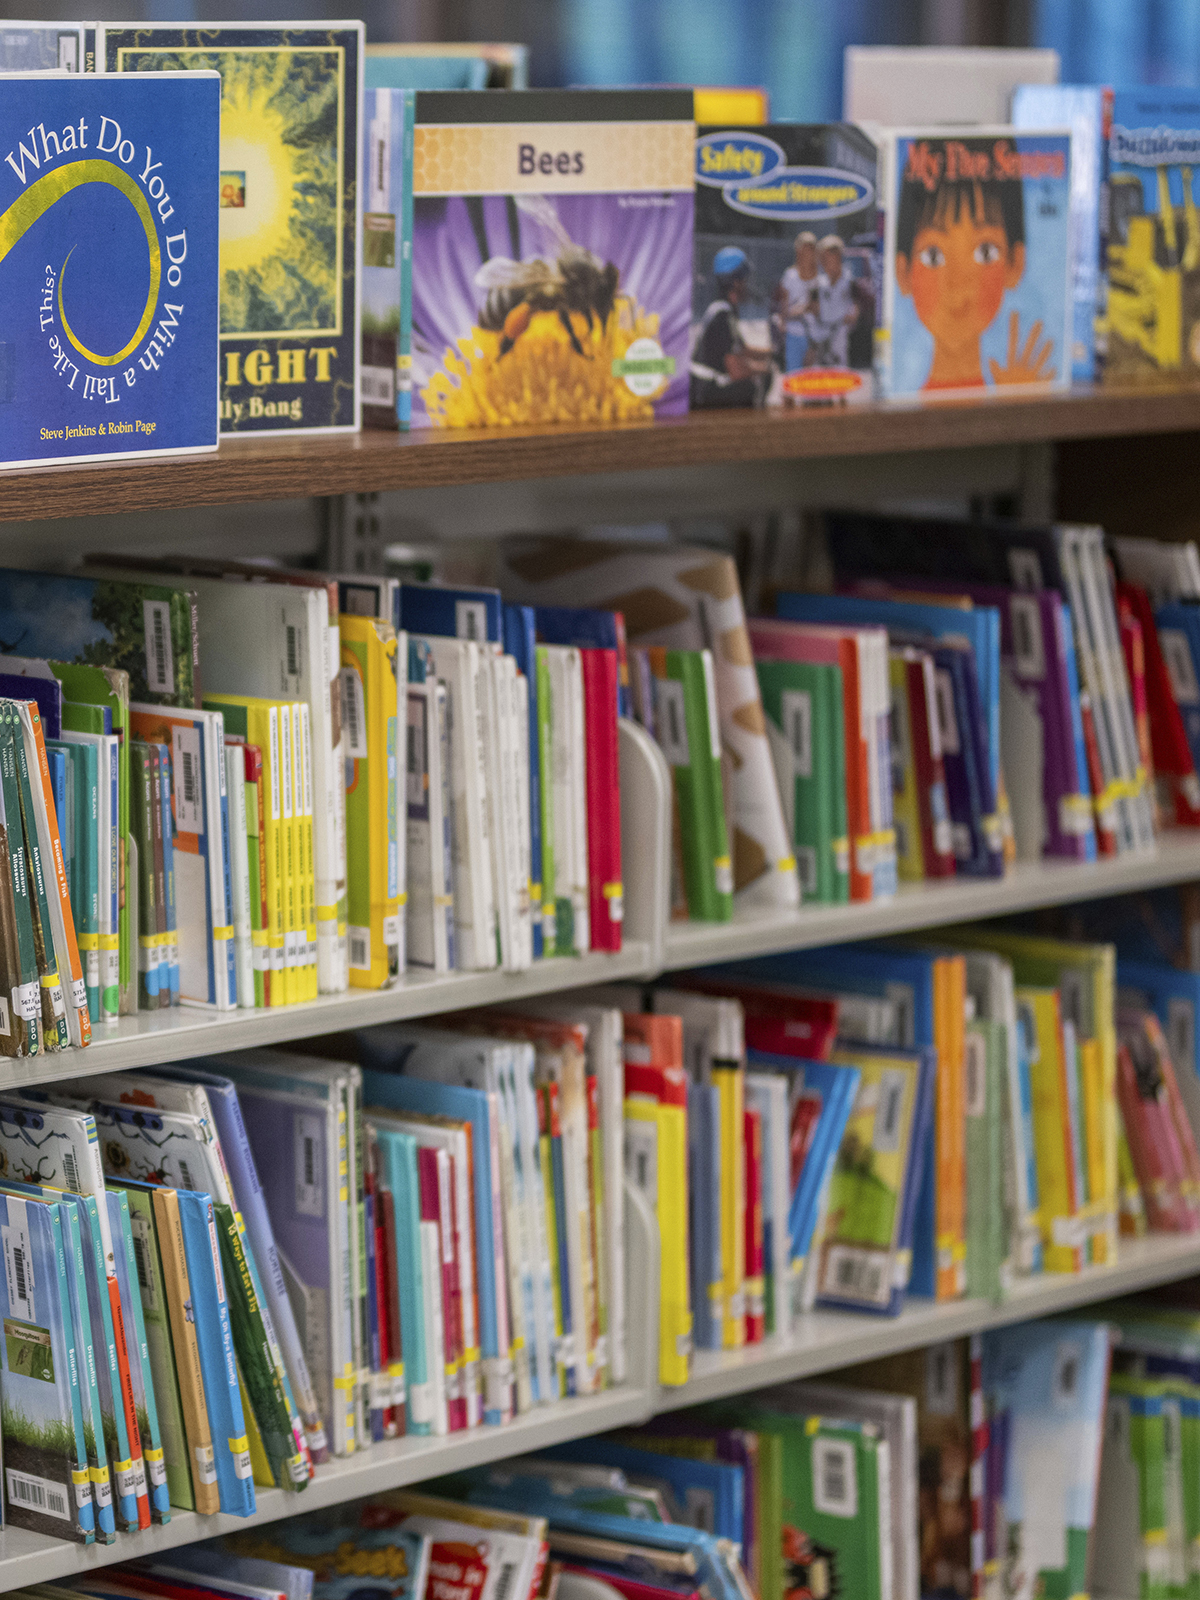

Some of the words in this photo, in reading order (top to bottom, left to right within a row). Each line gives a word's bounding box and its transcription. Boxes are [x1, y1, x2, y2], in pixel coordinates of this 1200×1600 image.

[4, 117, 89, 184] What
[96, 115, 135, 163] Do
[517, 144, 585, 175] Bees
[701, 144, 765, 177] Safety
[907, 141, 942, 193] My
[138, 146, 175, 224] You
[737, 182, 788, 205] around
[791, 181, 859, 208] Strangers
[166, 229, 187, 287] Do
[40, 264, 57, 332] This?
[138, 303, 184, 371] With
[49, 335, 80, 390] Like
[123, 367, 136, 387] a
[220, 347, 338, 386] IGHT
[83, 374, 120, 404] Tail
[249, 397, 303, 419] Bang
[40, 427, 64, 440] Steve
[65, 424, 97, 440] Jenkins
[98, 424, 107, 435] &
[108, 422, 133, 435] Robin
[135, 420, 157, 435] Page
[190, 603, 198, 665] Miller/Schuett
[40, 747, 48, 777] HANSEN
[7, 747, 15, 778] HANSEN
[17, 846, 27, 897] Styracosaurus
[20, 748, 28, 779] HANSEN
[33, 846, 45, 896] Ankylosaurus
[12, 853, 20, 893] Allosaurus
[53, 838, 64, 870] Becoming
[60, 881, 68, 898] Fish
[228, 1101, 248, 1140] FLEMING
[239, 1145, 263, 1195] ROHMANN
[126, 1233, 135, 1262] HANSEN
[226, 1223, 238, 1236] 13
[227, 1236, 244, 1262] Ways
[237, 1261, 248, 1272] to
[240, 1272, 253, 1289] Eat
[58, 1248, 66, 1277] HANSEN
[69, 1348, 77, 1387] Butterflies
[76, 1246, 84, 1276] HANSEN
[87, 1345, 96, 1387] Dragonflies
[95, 1239, 103, 1268] HANSEN
[108, 1344, 116, 1372] Beetles
[219, 1307, 227, 1319] My,
[244, 1296, 260, 1315] Fly
[13, 1329, 41, 1342] Mosquitoes
[221, 1320, 228, 1330] Oh
[225, 1351, 237, 1387] Butterfly!
